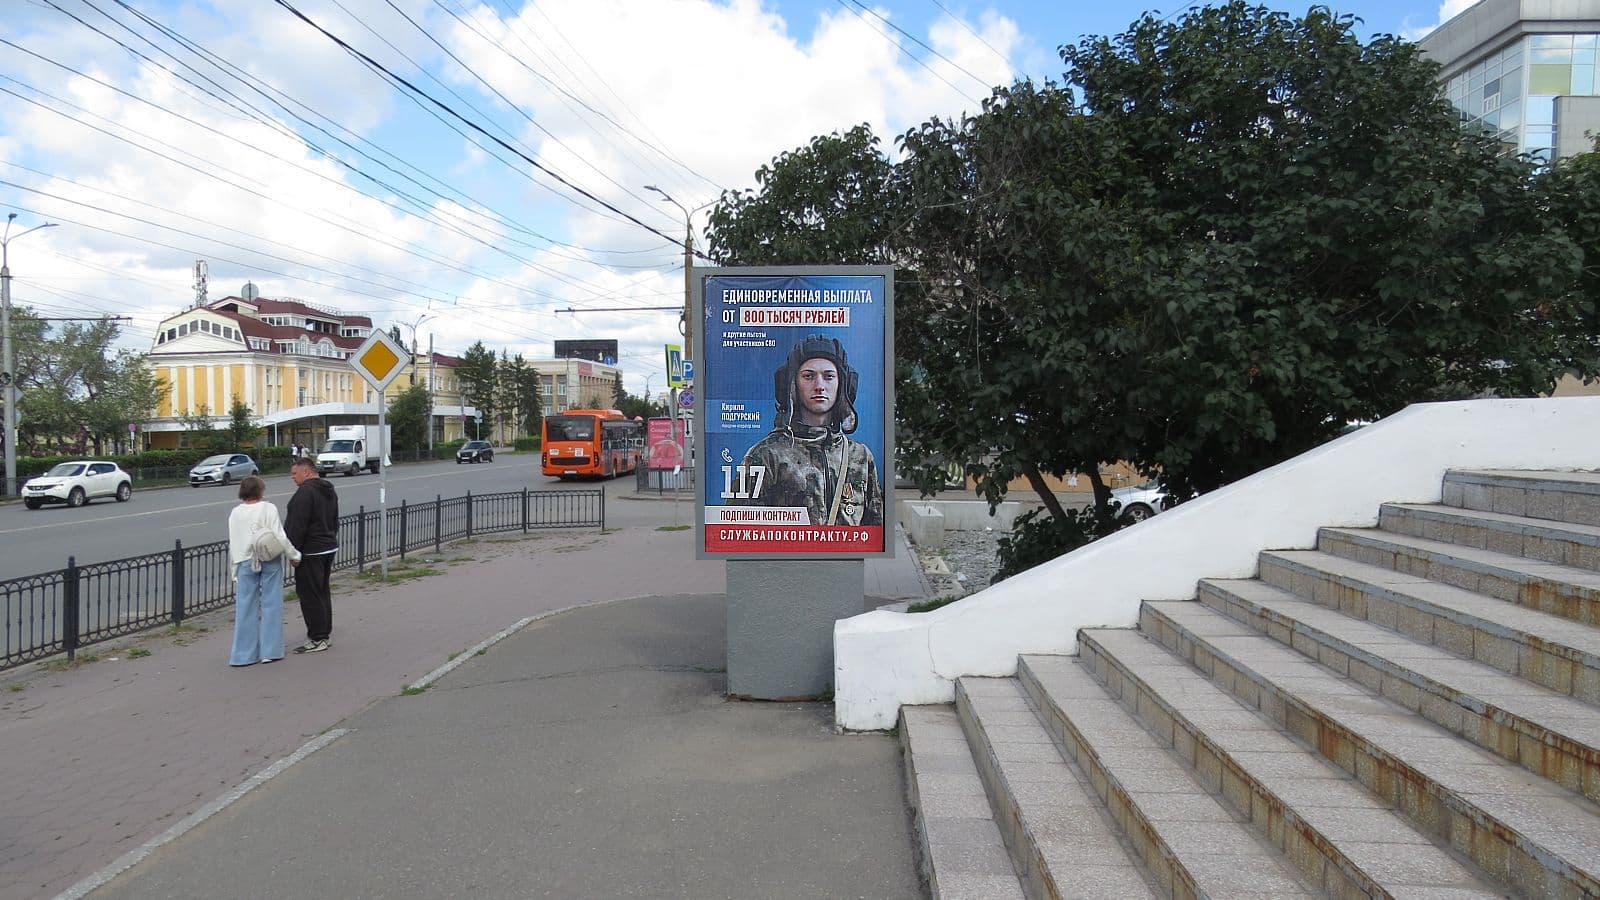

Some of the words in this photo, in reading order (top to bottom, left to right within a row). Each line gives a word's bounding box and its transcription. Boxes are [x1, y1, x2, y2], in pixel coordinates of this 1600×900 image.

[722, 289, 821, 304] ЕДИНОВРЕМЕННАЯ
[823, 289, 873, 304] ВЫПЛАТА
[722, 309, 736, 323] ОТ
[744, 310, 765, 324] 800
[766, 310, 802, 324] ТЫСЯЧ
[805, 308, 845, 324] РУБЛЕЙ
[733, 340, 765, 348] участников
[765, 339, 776, 347] СВО
[721, 402, 745, 412] Кирилл
[721, 411, 760, 422] ПОДГУРСКИЙ
[720, 465, 766, 499] 117
[720, 510, 761, 522] ПОДПИШИ
[762, 511, 802, 522] КОНТРАКТ
[720, 529, 869, 542] СЛУЖБАПОКОНТРАКТУ.РФ
